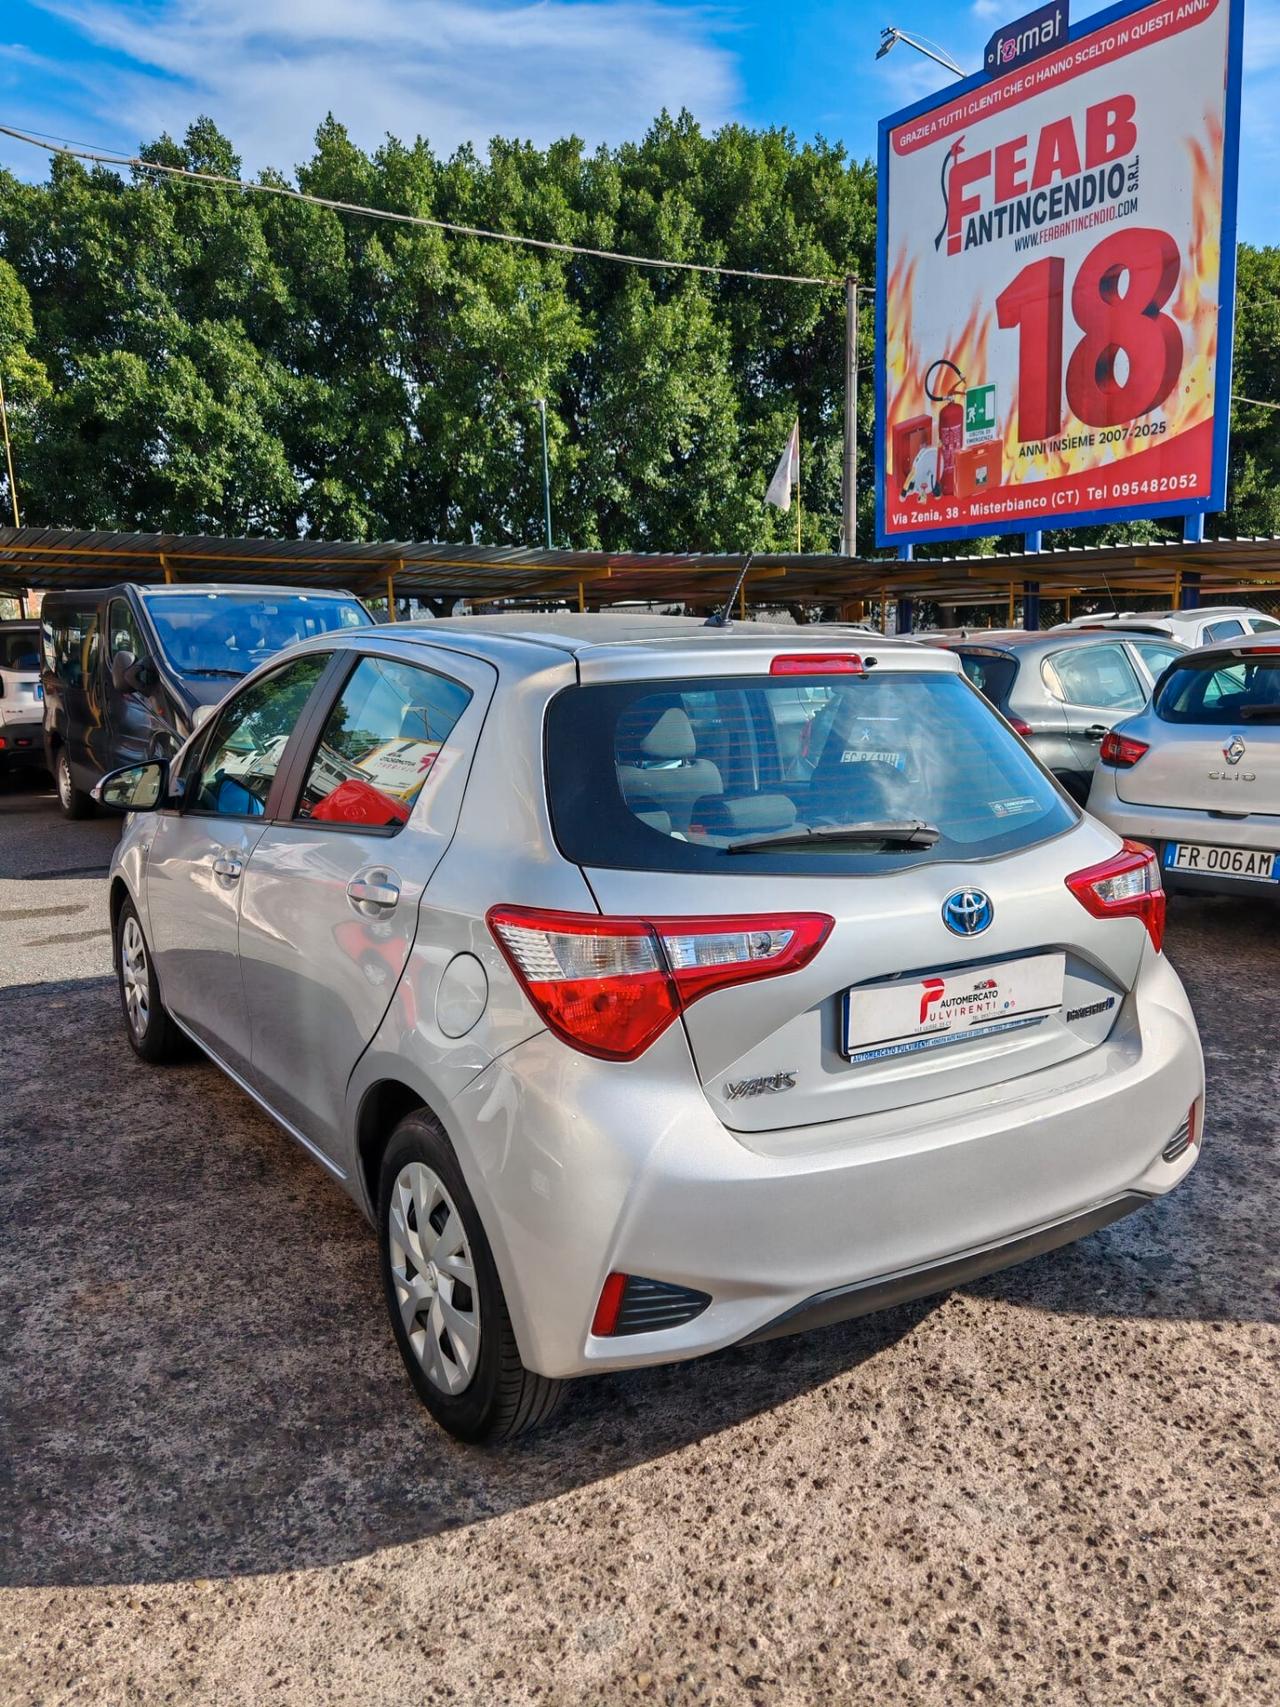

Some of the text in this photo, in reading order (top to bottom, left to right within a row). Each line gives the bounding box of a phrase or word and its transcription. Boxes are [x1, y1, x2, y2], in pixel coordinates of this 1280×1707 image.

[900, 125, 930, 146] GRAZIE
[930, 122, 937, 134] A
[938, 110, 962, 128] TUTTI
[968, 90, 1001, 114] CLIENTI
[1004, 81, 1023, 98] CHE
[1024, 76, 1035, 88] CI
[1036, 57, 1073, 83] HANNO
[1075, 37, 1115, 64] SCELTO
[1117, 30, 1129, 46] IN
[1131, 11, 1174, 39] QUESTI
[947, 94, 1138, 256] FEAB
[1127, 154, 1139, 193] S.R.L.
[965, 163, 1125, 251] ANTINCENDIO
[1014, 198, 1138, 252] WWW.FEABANTINCENDIO.COM
[995, 227, 1184, 443] 18
[1019, 421, 1167, 458] ANNI INSIEME 2007-2025
[893, 512, 907, 525] Via
[911, 508, 942, 522] Zenia,
[946, 507, 959, 519] 38
[970, 496, 1047, 516] Misterbianco
[1051, 489, 1080, 508] (CT)
[1087, 484, 1107, 500] Tel
[1112, 473, 1198, 498] 095482052
[1207, 770, 1257, 782] CLIO
[1176, 846, 1272, 875] FR 006AM
[940, 990, 998, 1008] AUTOMERCATO
